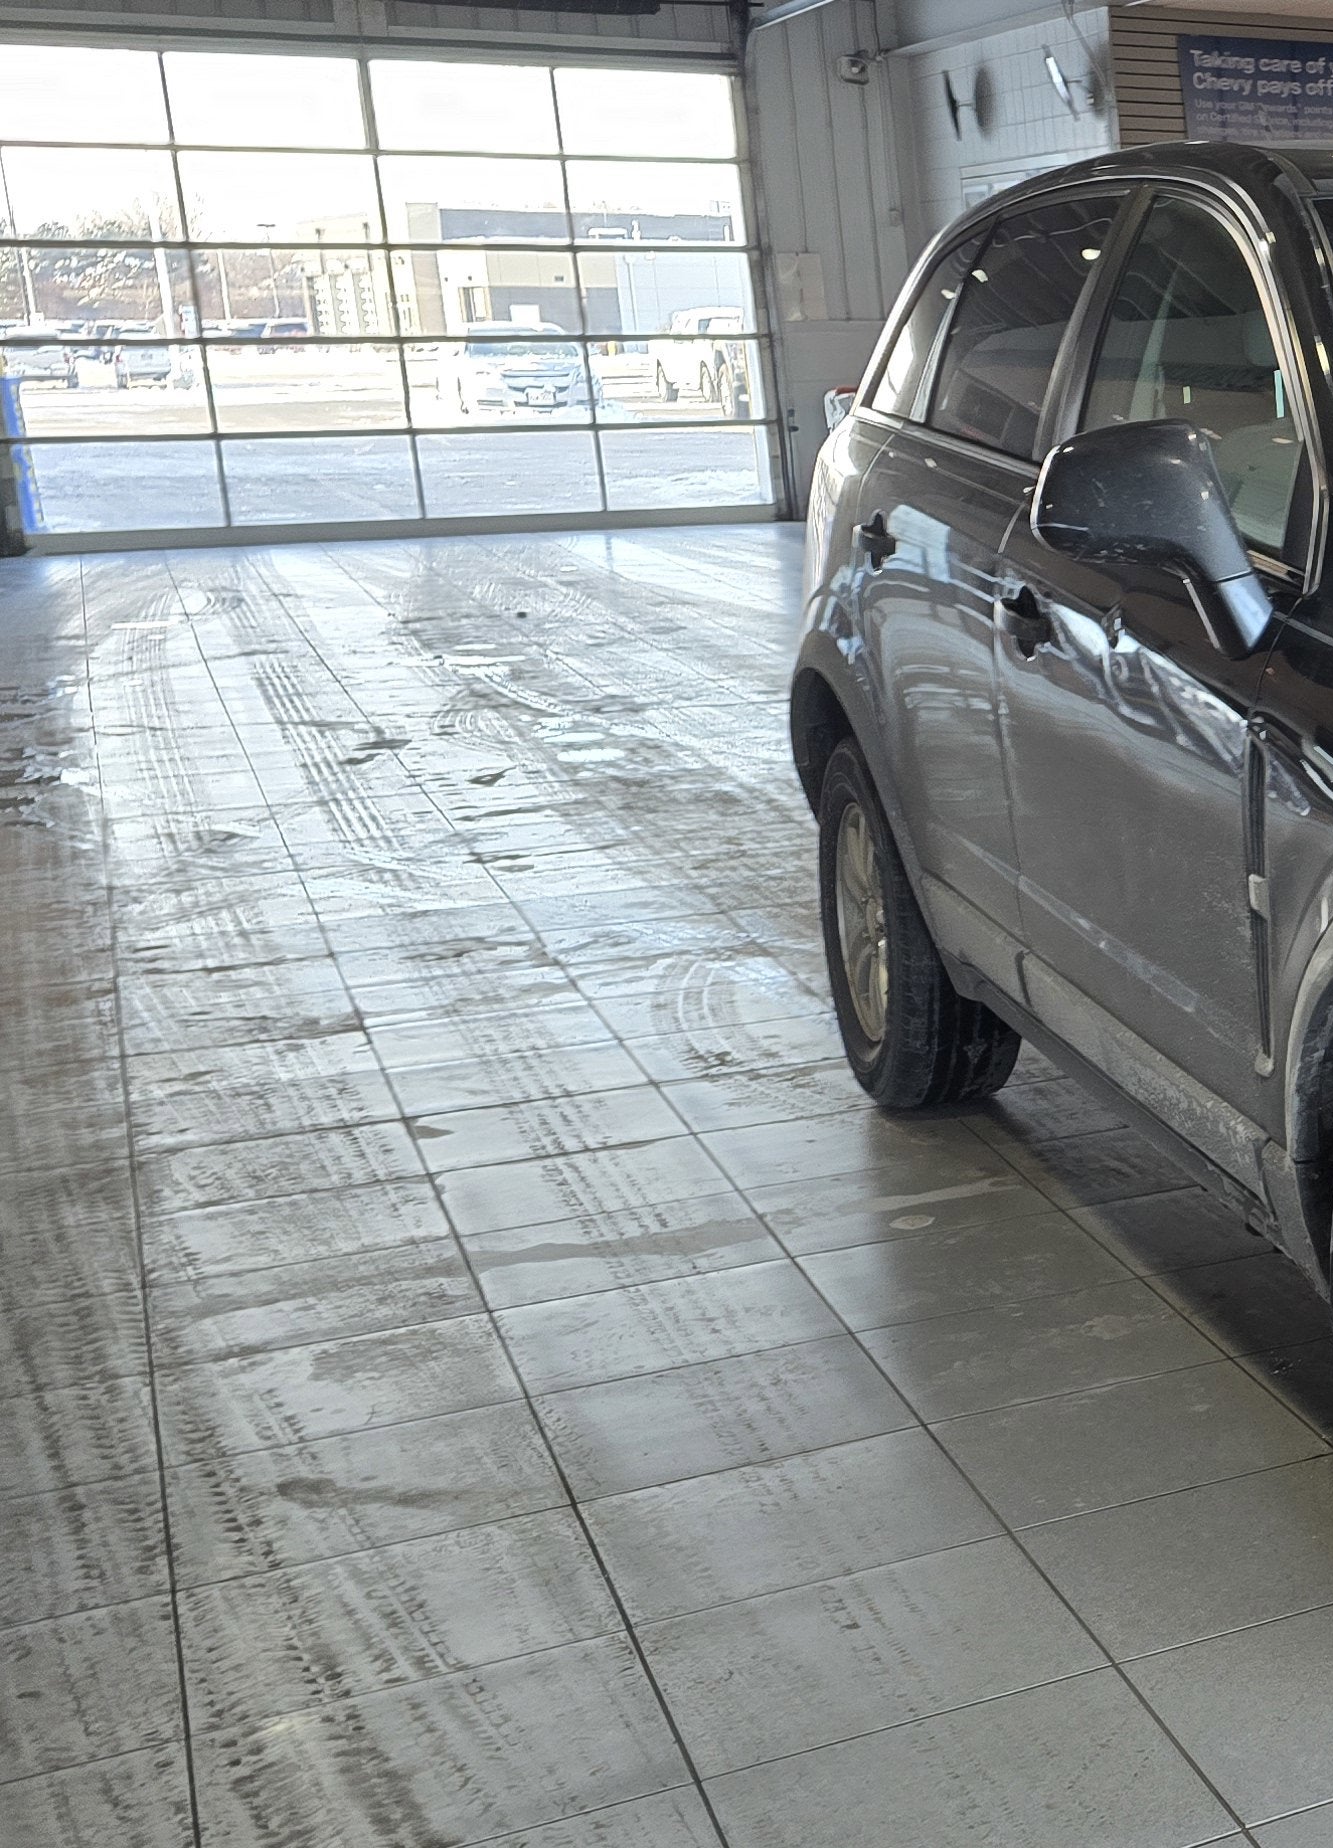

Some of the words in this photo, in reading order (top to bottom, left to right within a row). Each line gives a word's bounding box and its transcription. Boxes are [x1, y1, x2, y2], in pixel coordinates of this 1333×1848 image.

[1189, 50, 1255, 74] Taking
[1258, 58, 1302, 73] care
[1305, 57, 1326, 74] of
[1192, 72, 1253, 96] Chevy
[1256, 79, 1302, 97] pays
